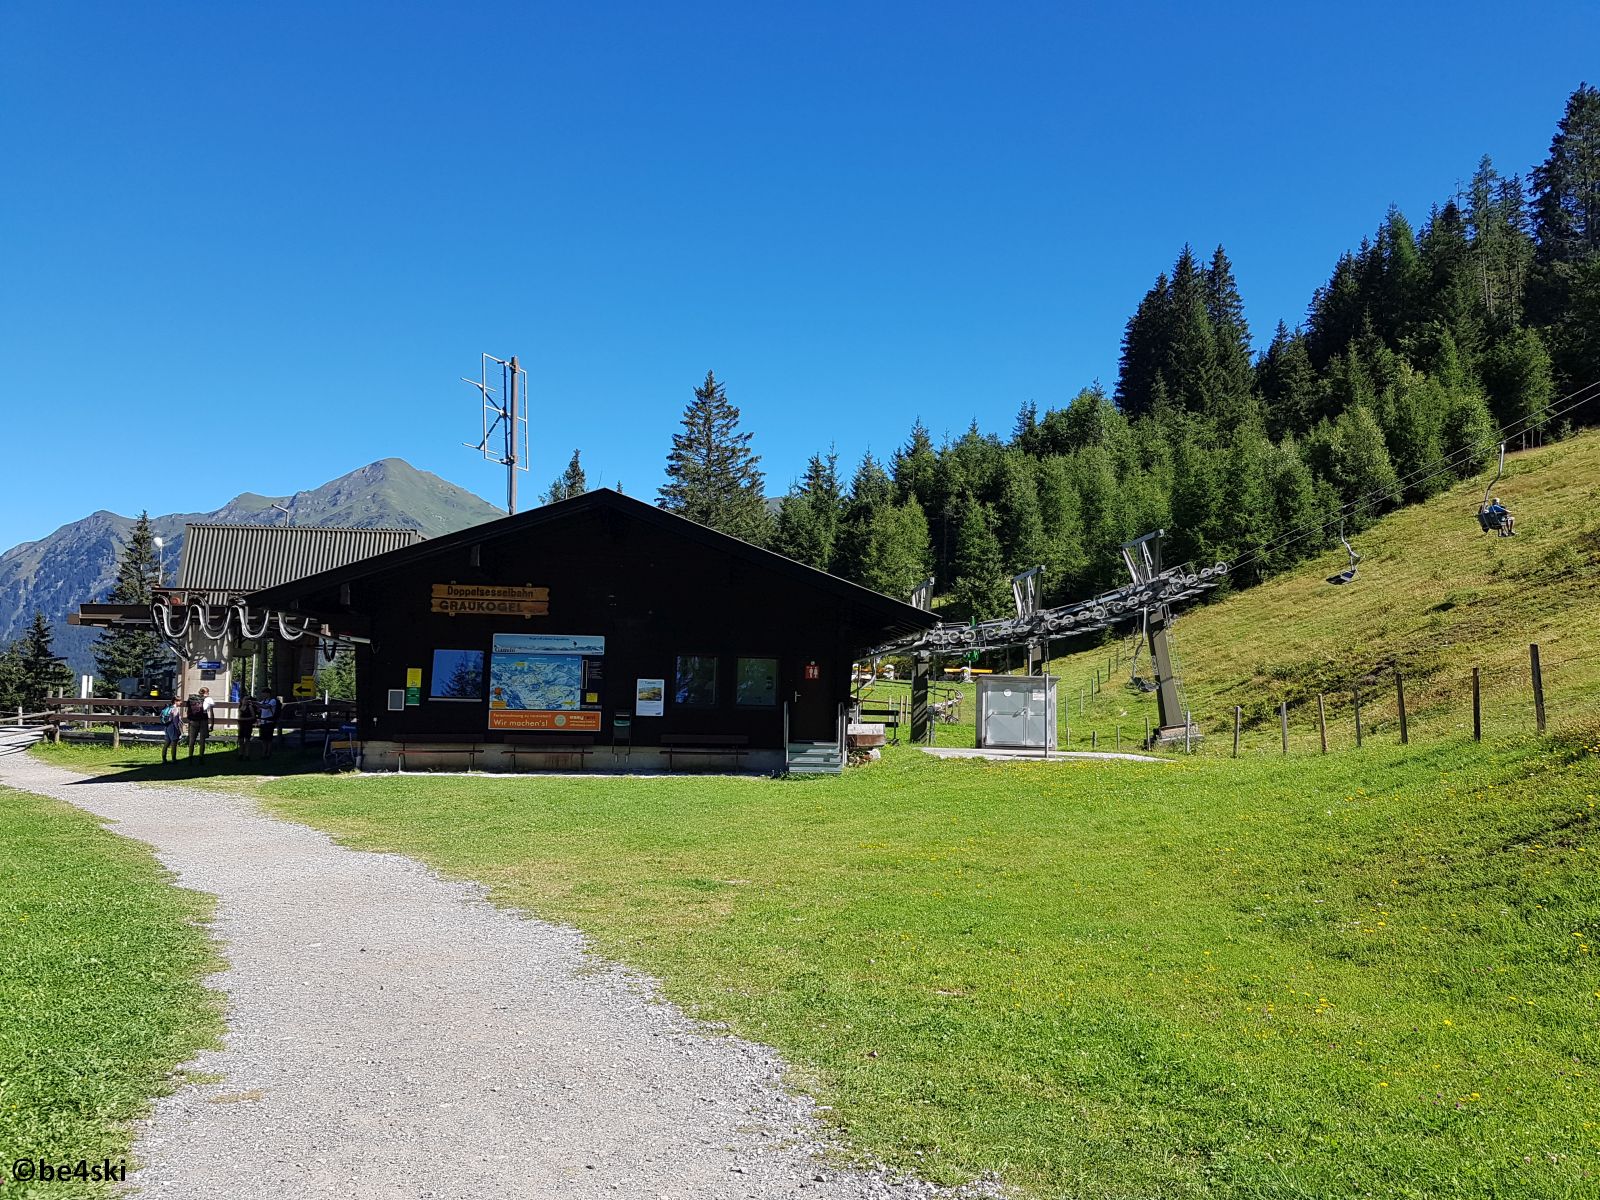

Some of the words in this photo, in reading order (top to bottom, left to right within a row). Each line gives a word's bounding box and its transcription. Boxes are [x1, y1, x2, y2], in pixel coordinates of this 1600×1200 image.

[447, 585, 533, 599] Doppelsesselbahn
[439, 600, 524, 613] GRAUKOGEL
[493, 719, 507, 727] Wir
